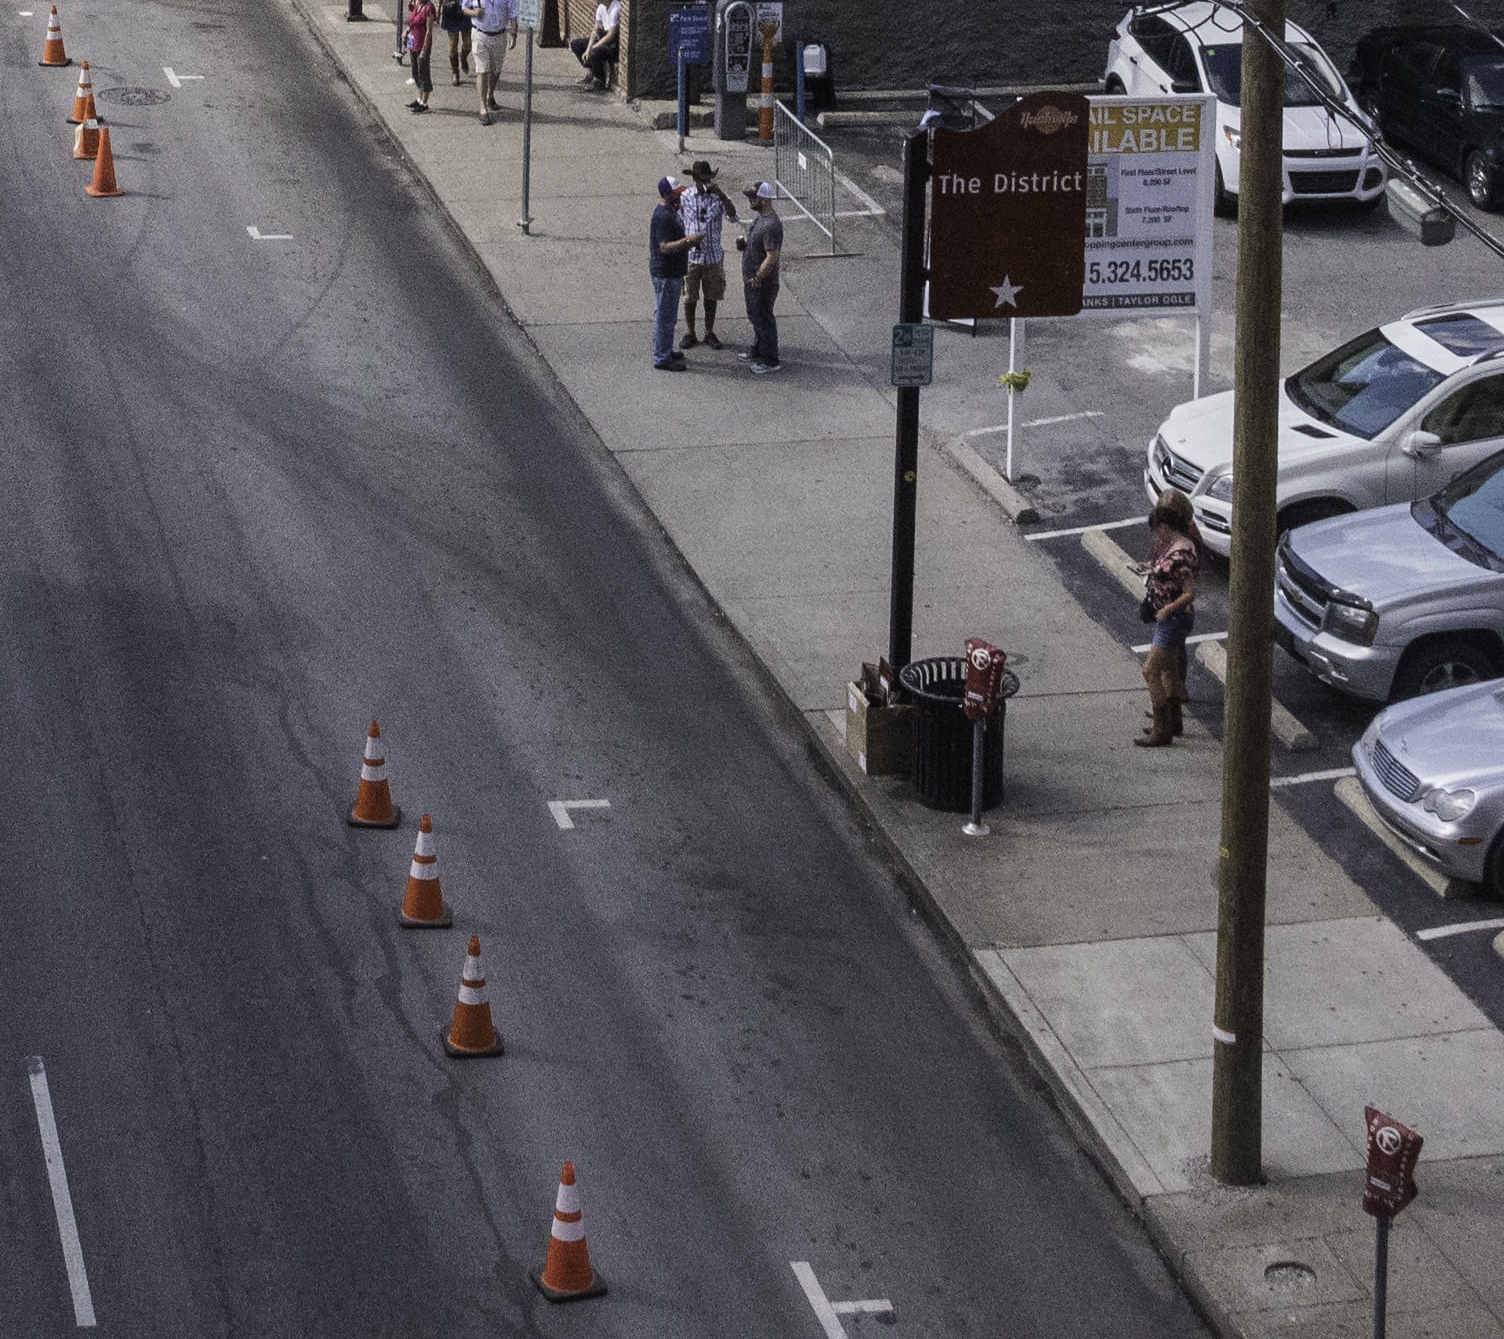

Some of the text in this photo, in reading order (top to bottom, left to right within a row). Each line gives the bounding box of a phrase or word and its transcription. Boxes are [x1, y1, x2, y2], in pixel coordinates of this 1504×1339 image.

[1123, 104, 1196, 124] SPACE
[1089, 127, 1196, 153] ILABLE
[938, 171, 1082, 195] The District
[1087, 257, 1194, 284] 5.324.5653
[1117, 295, 1159, 306] TAYLOR
